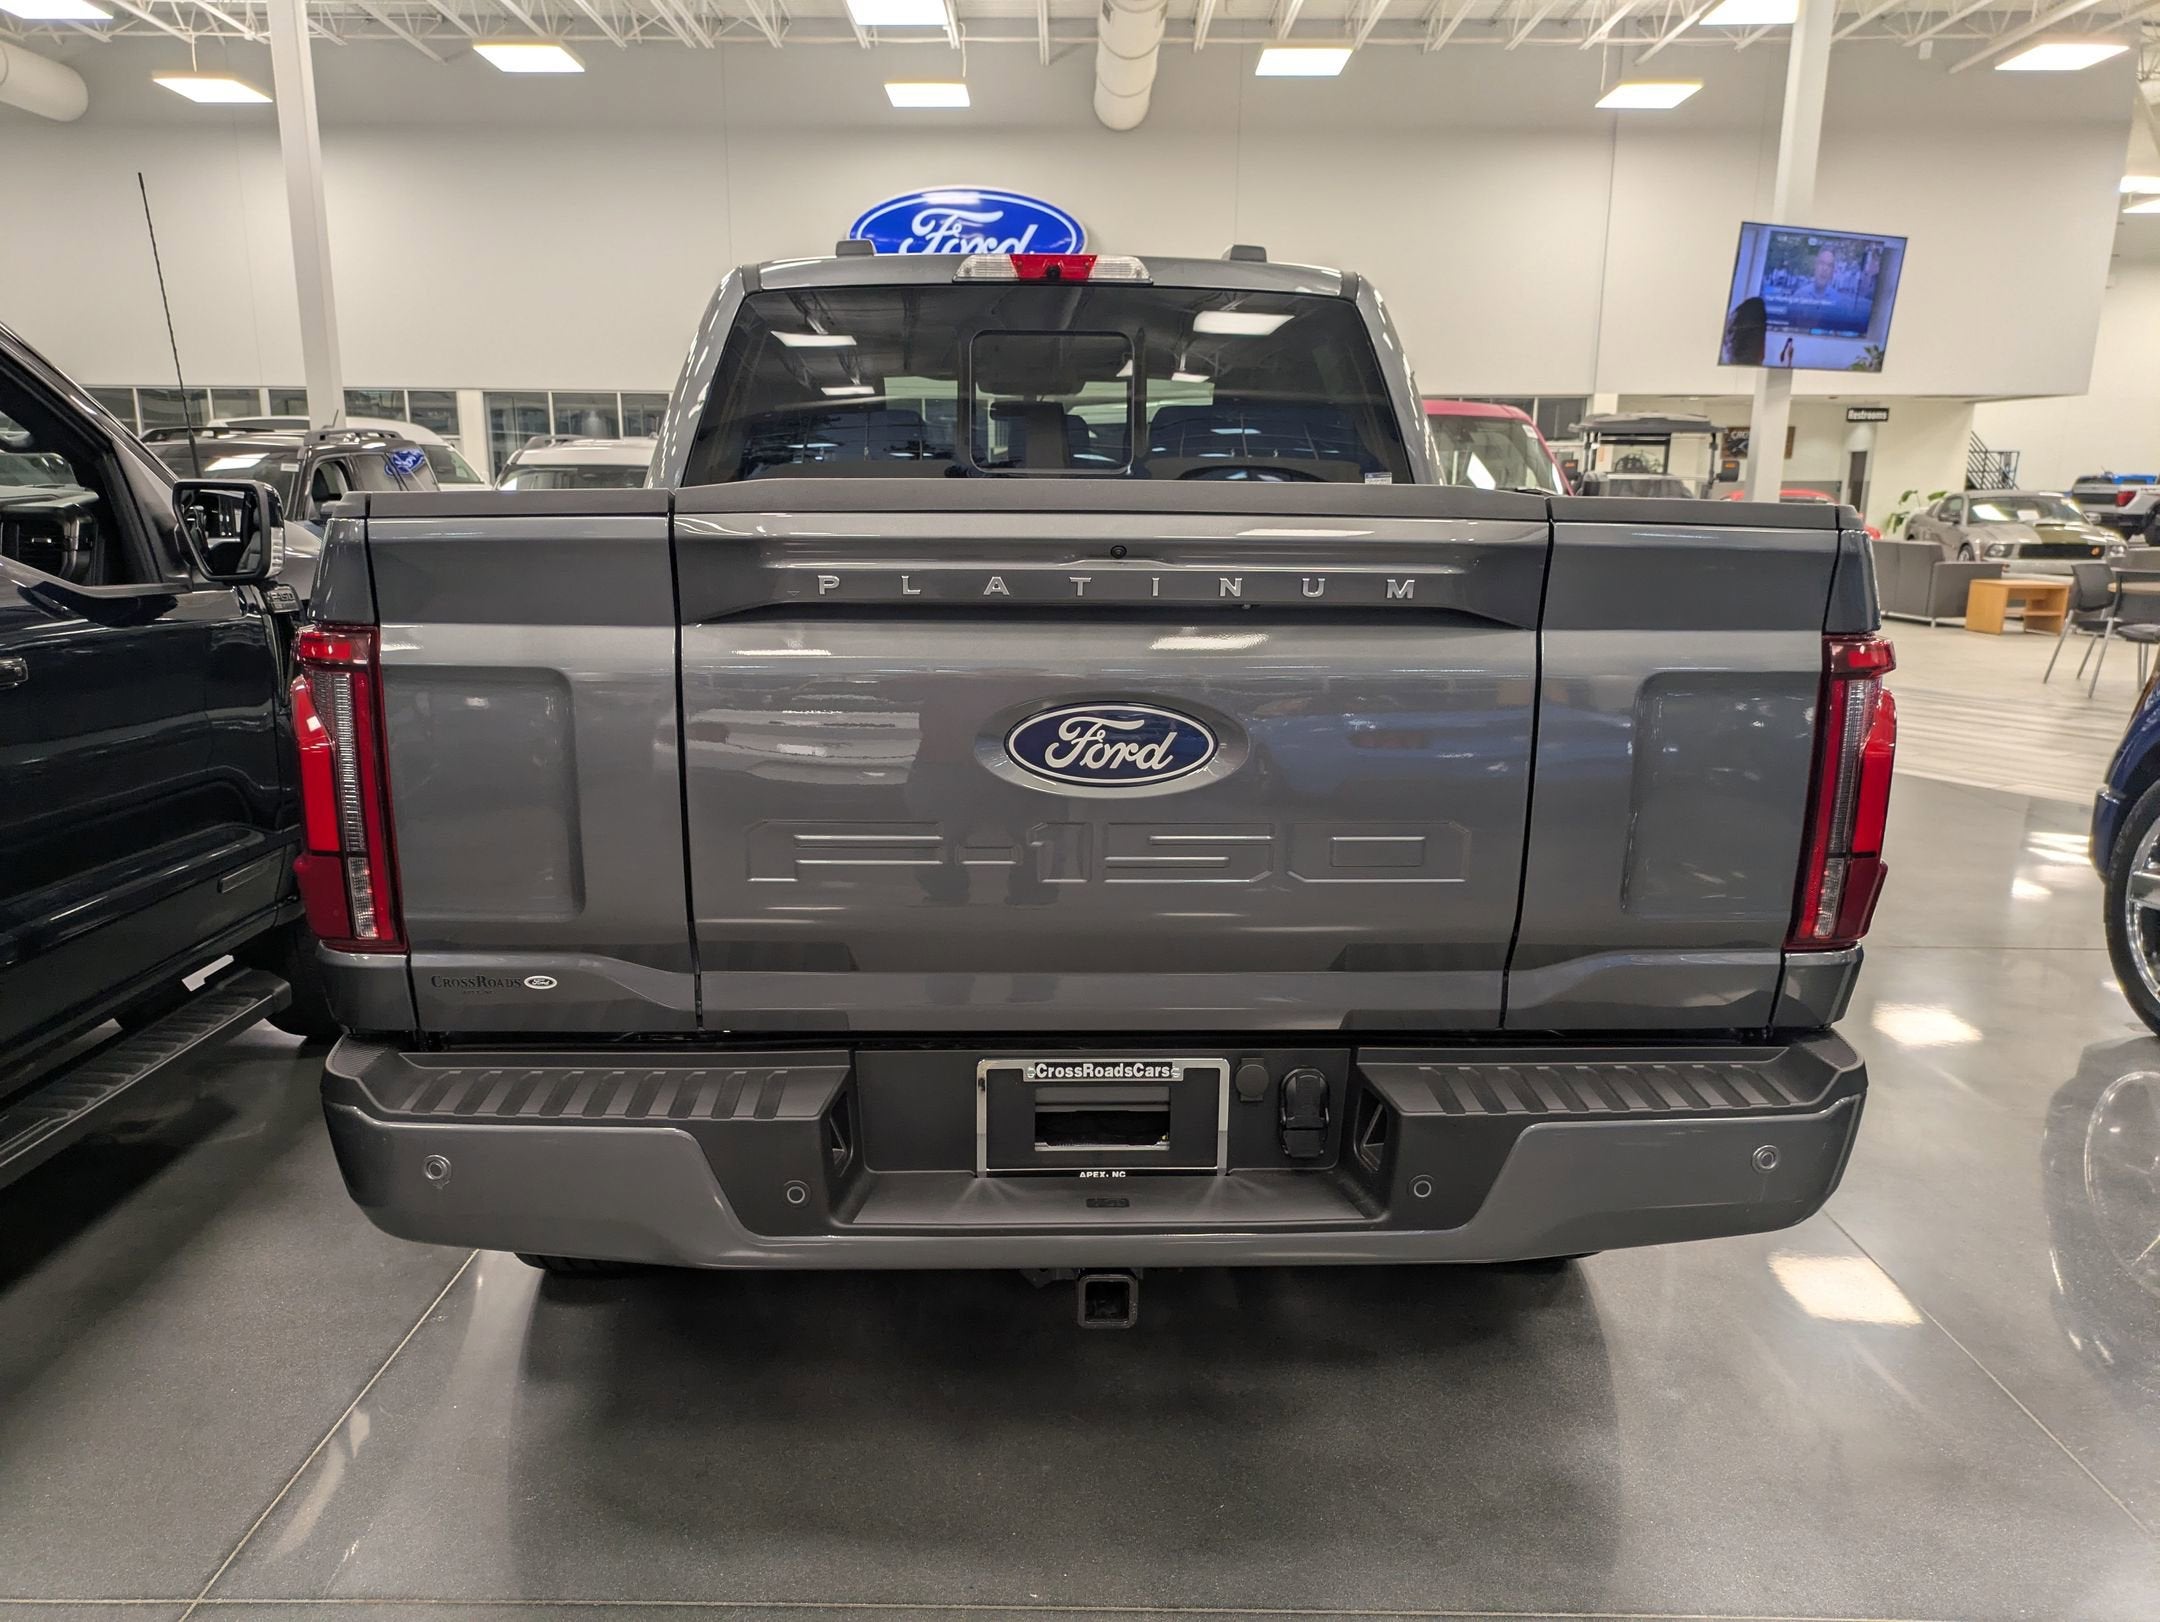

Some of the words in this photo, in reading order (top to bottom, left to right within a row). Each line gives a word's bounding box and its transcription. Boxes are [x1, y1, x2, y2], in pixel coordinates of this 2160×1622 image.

[898, 207, 1039, 255] Ford
[817, 574, 1415, 600] PLATINUM
[1044, 715, 1178, 770] Ford
[746, 819, 1472, 884] F-150
[1035, 1062, 1171, 1079] CrossRoadsCars
[1111, 1170, 1127, 1178] NC
